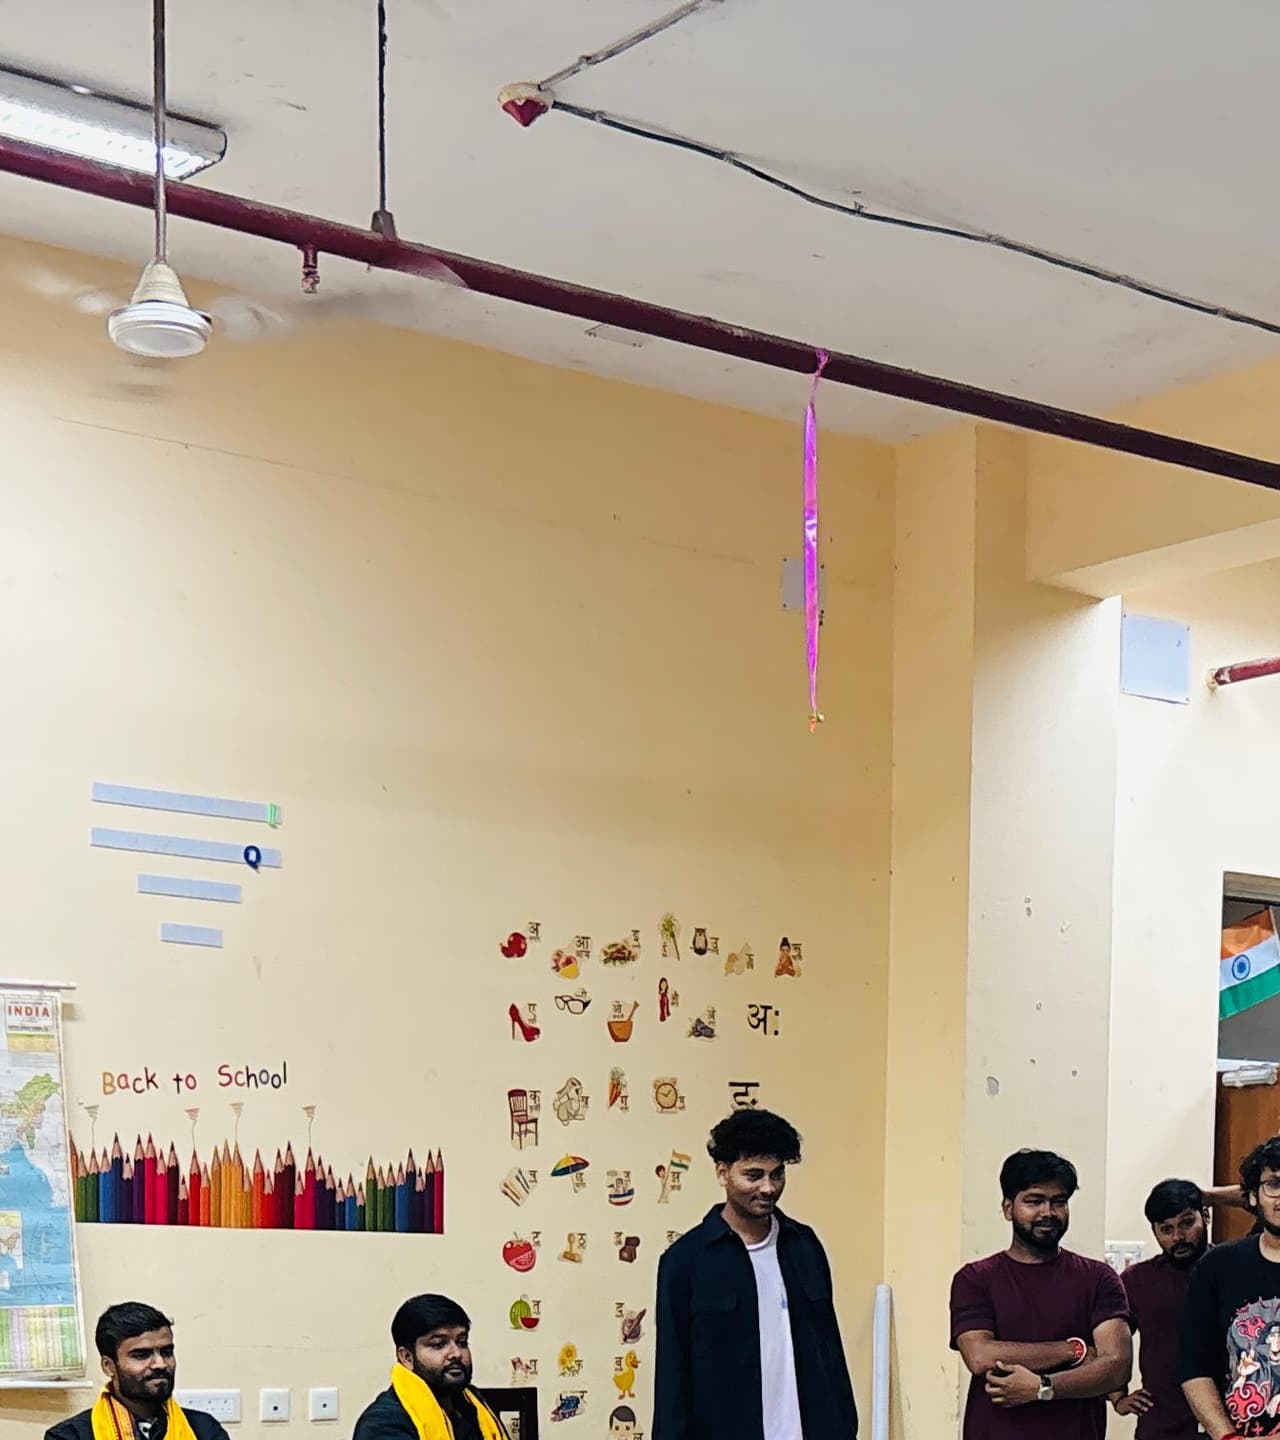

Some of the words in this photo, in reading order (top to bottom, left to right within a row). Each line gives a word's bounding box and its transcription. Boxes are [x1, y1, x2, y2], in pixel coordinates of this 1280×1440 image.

[243, 845, 261, 871] Q
[7, 1005, 50, 1018] INDIA
[102, 1066, 159, 1095] Back
[172, 1073, 197, 1094] to
[218, 1060, 287, 1089] School
